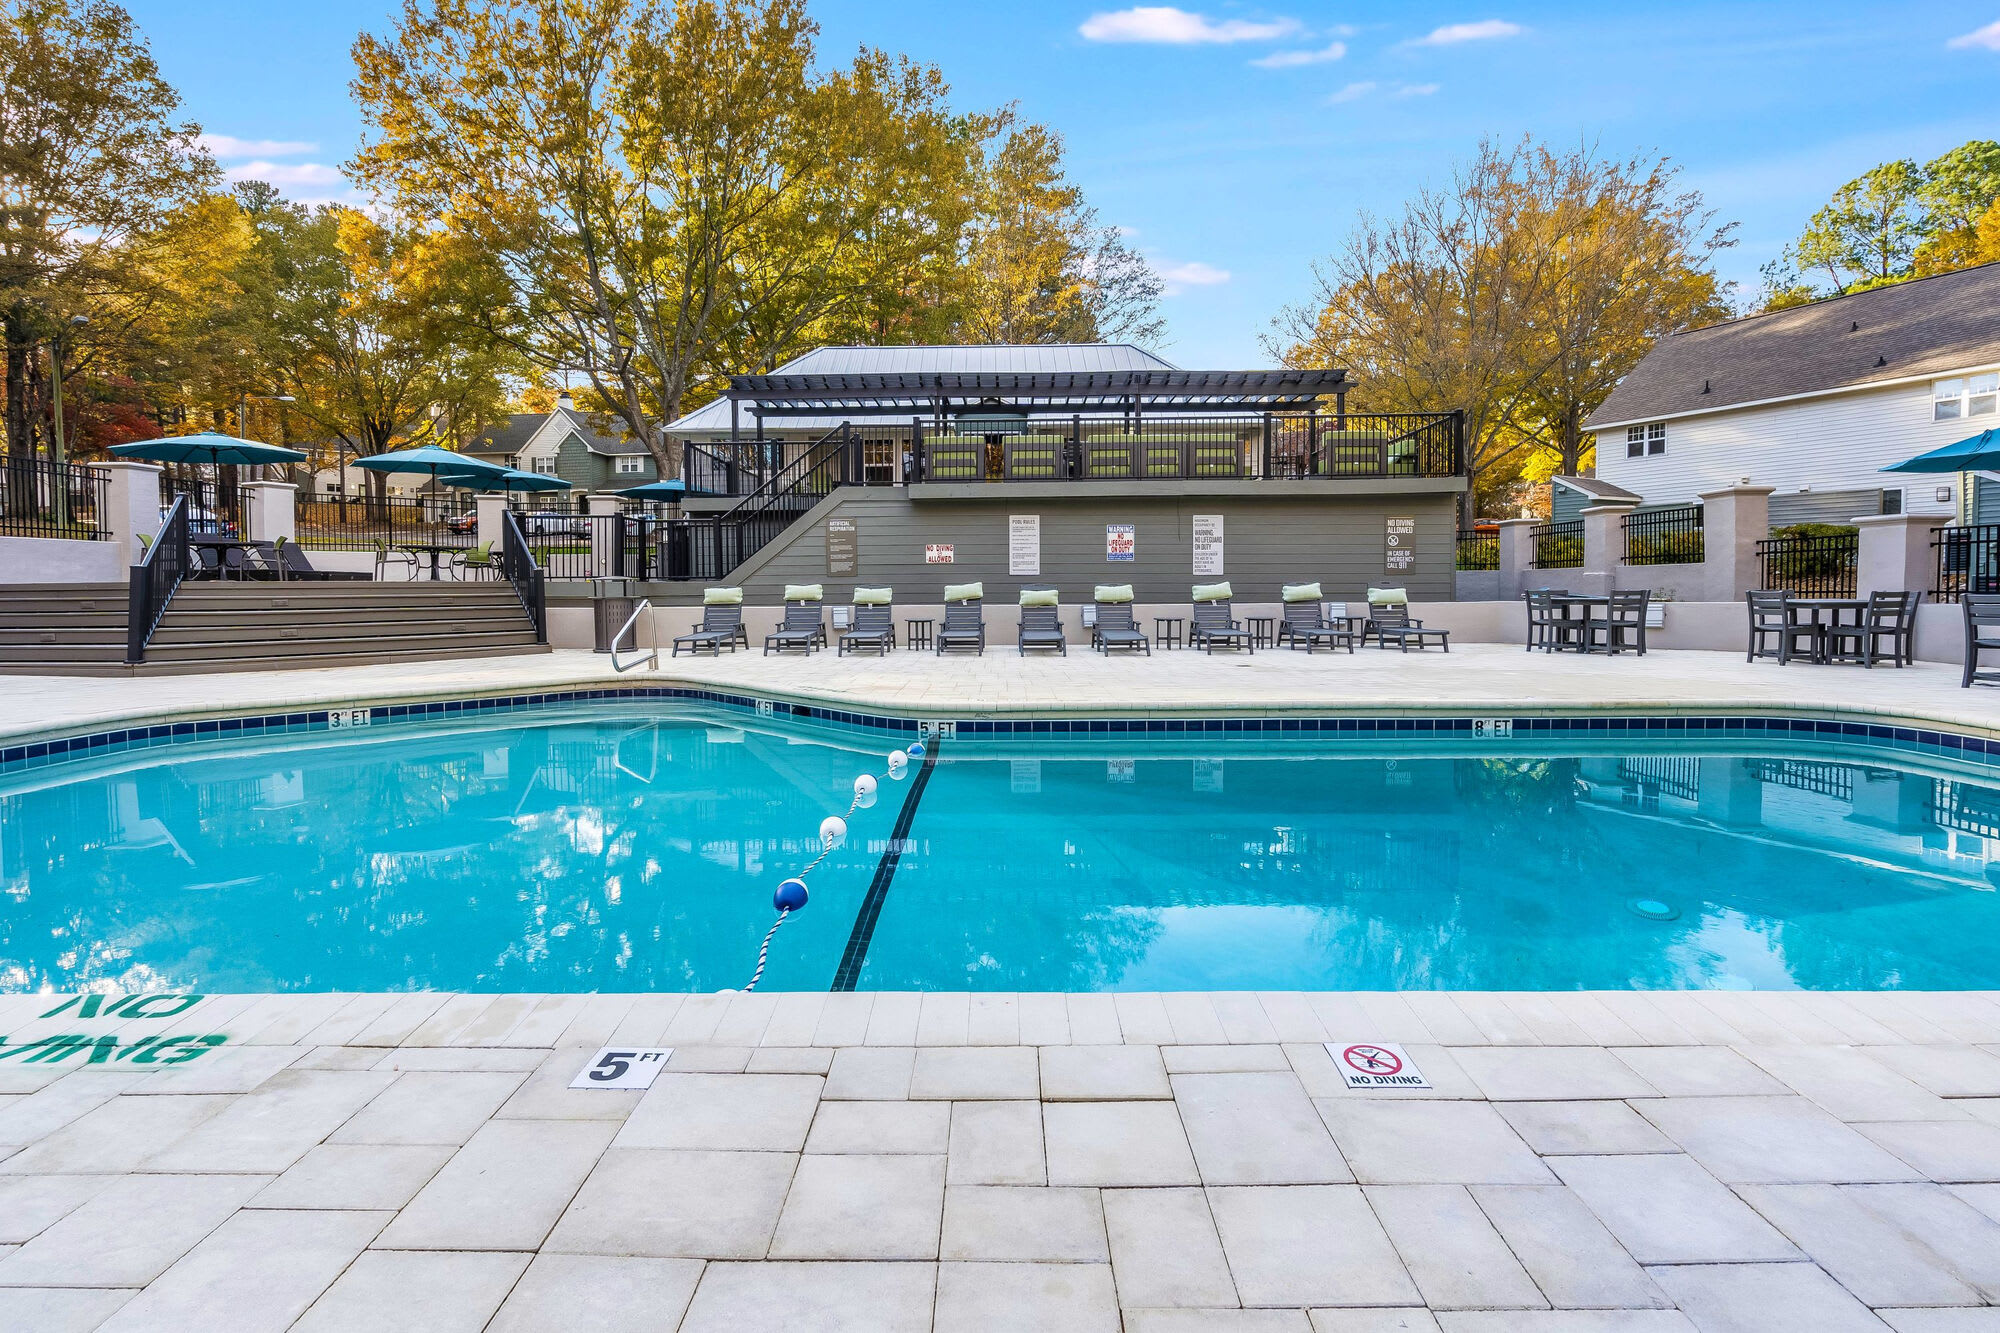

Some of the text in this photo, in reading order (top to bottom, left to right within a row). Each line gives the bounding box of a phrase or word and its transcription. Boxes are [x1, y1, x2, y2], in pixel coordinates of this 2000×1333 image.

[38, 994, 205, 1018] NO
[589, 1053, 664, 1081] 5 FT
[1350, 1076, 1422, 1084] NO DIVING
